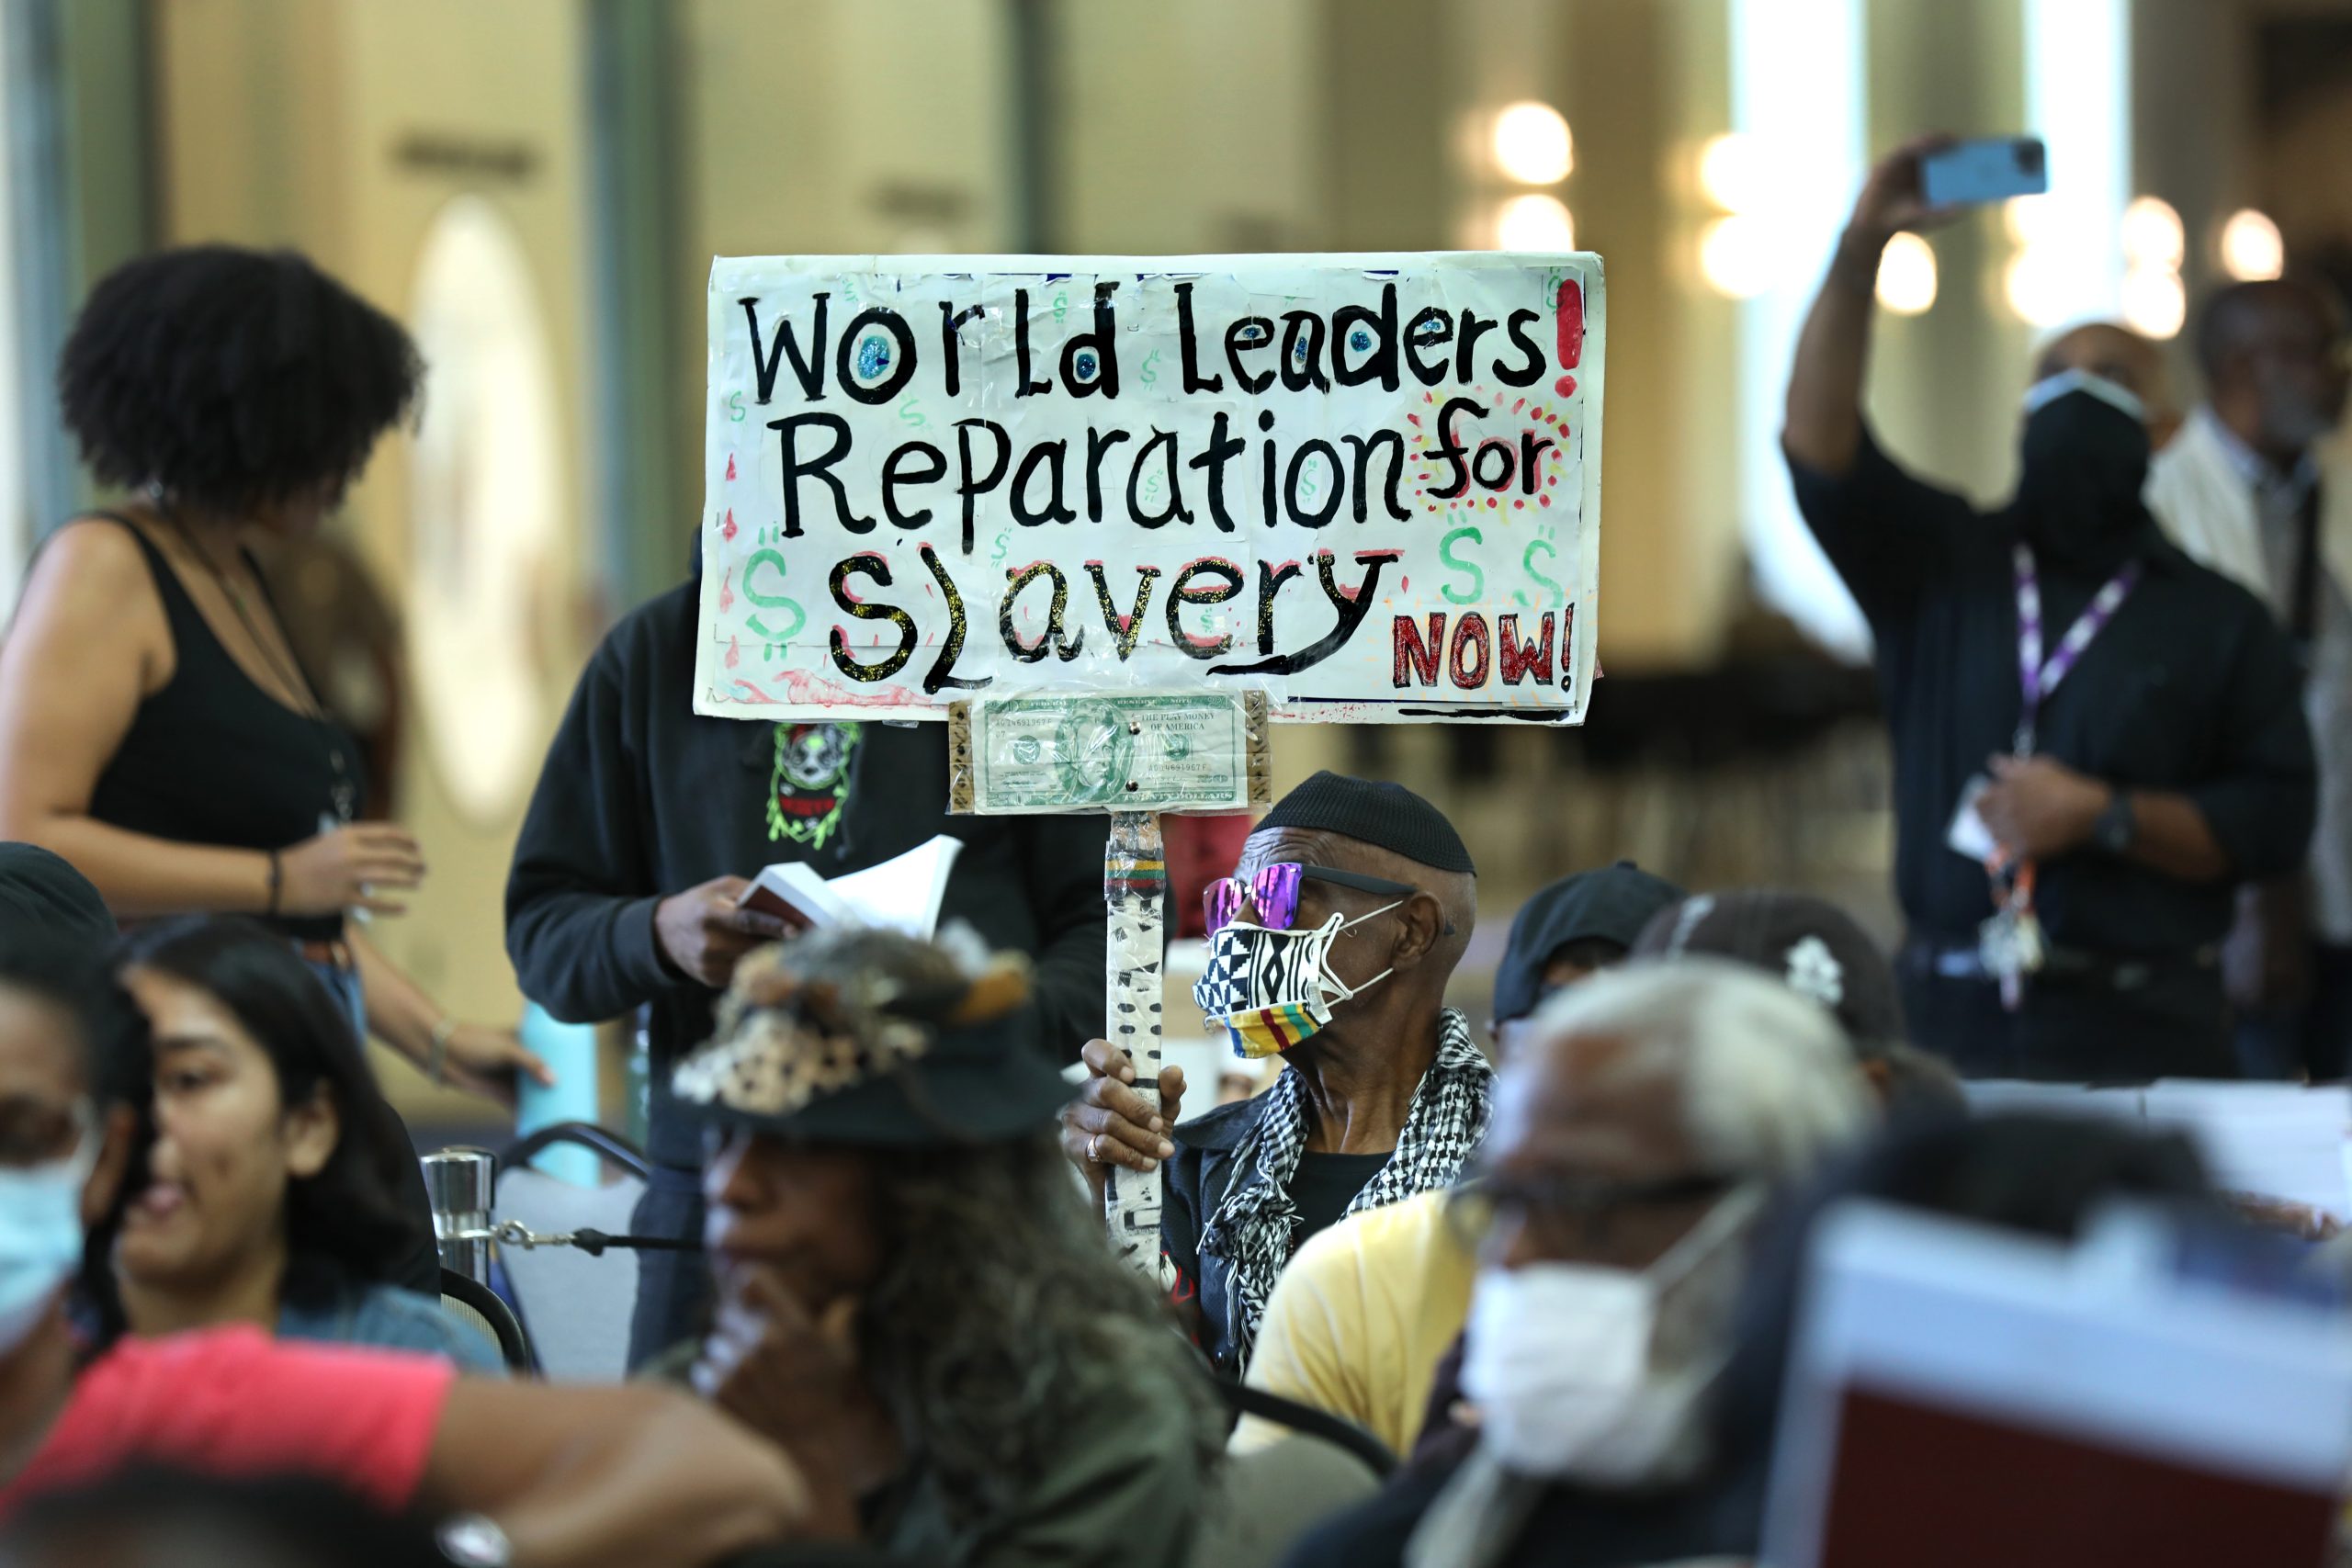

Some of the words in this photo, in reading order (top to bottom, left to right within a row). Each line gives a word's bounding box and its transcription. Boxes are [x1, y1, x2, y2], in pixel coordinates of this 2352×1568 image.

[1174, 277, 1584, 399] Leaders!
[766, 409, 1413, 555] Reparation
[1422, 396, 1555, 500] for
[829, 543, 1405, 694] Slavery
[1393, 602, 1576, 693] NOW!
[1150, 723, 1162, 731] OF
[1165, 722, 1205, 731] AMERICA
[1183, 711, 1216, 721] MONEY
